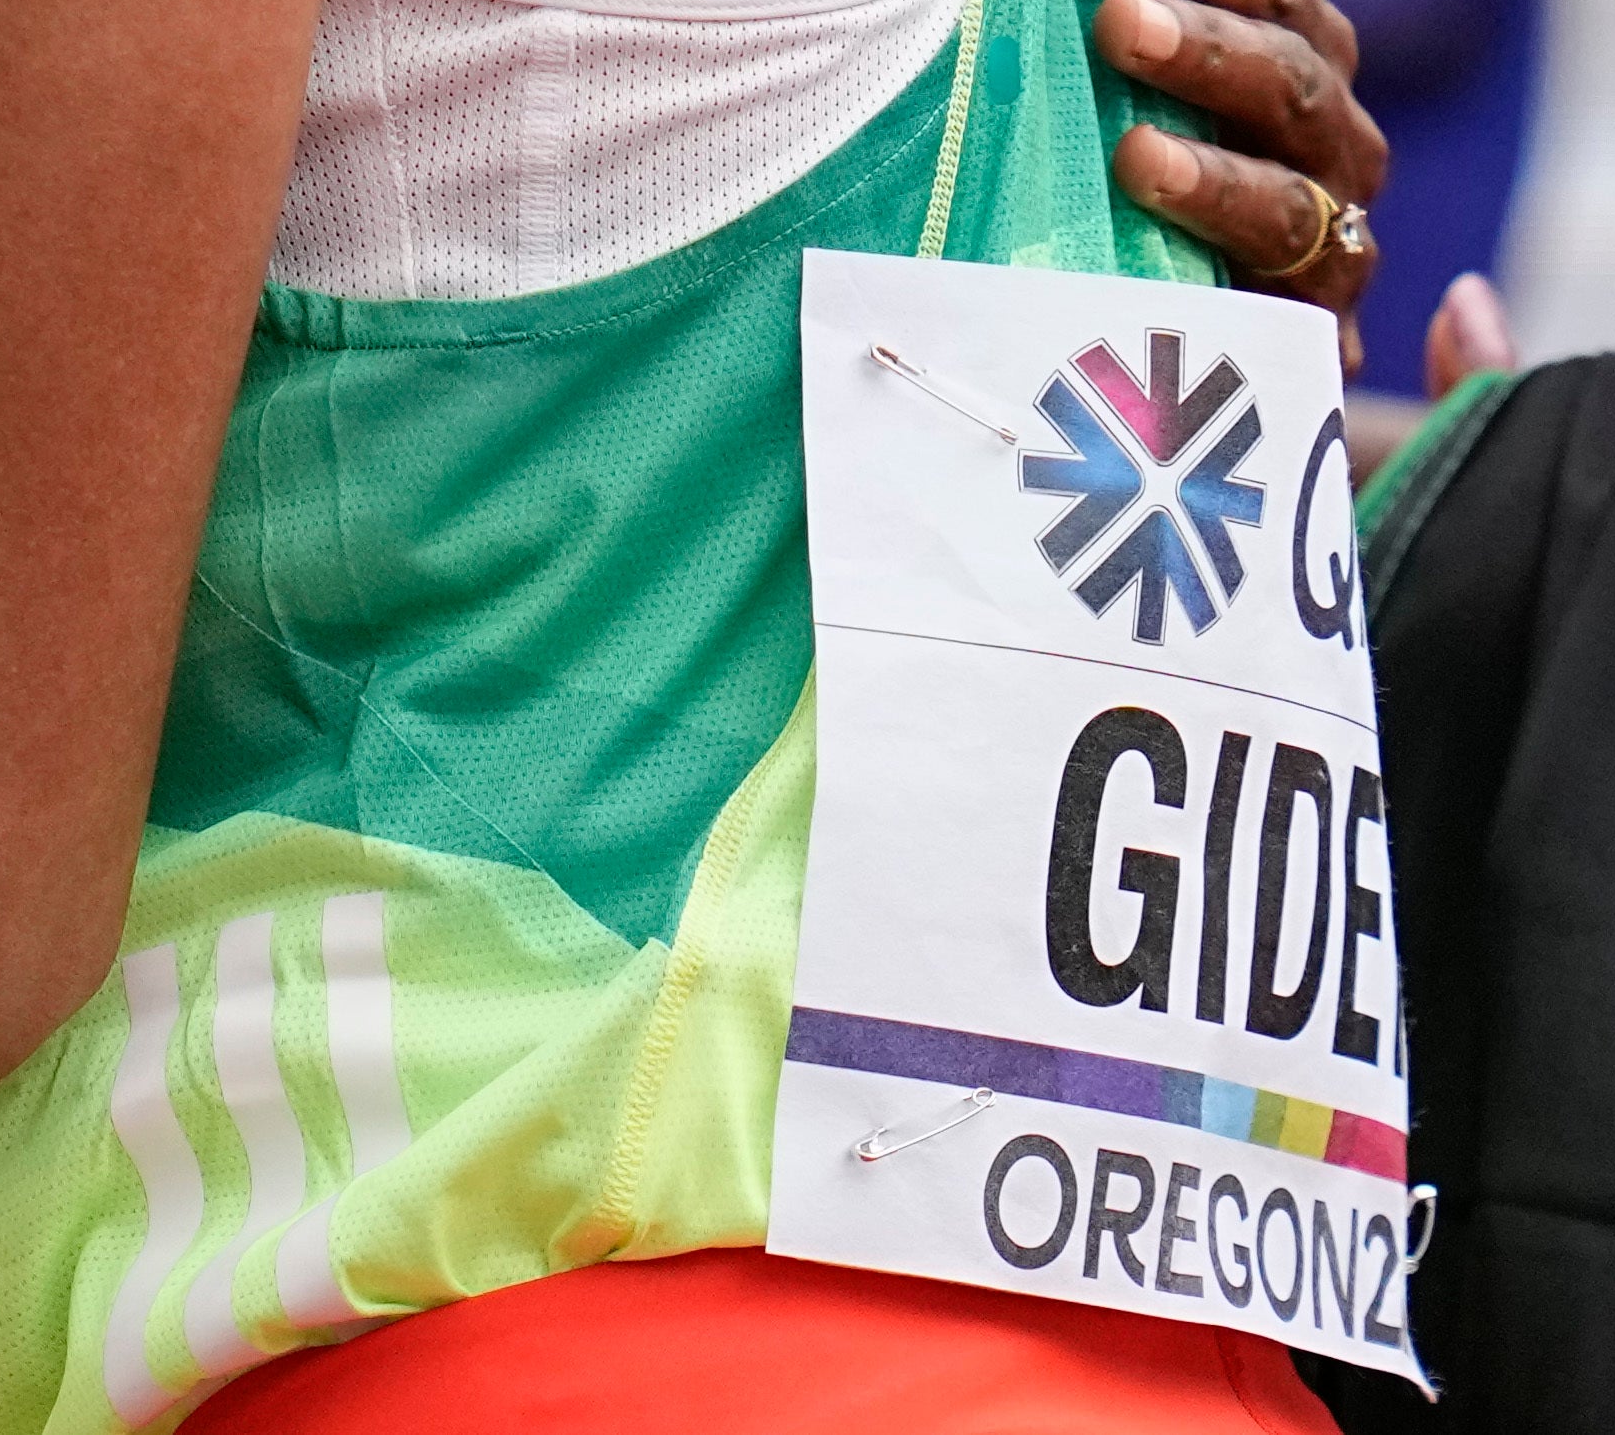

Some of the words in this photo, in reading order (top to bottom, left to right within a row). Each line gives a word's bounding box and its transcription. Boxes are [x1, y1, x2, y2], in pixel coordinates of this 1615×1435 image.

[1293, 407, 1366, 651] Q
[1045, 705, 1405, 1078] GIDE
[983, 1133, 1408, 1355] OREGON2
